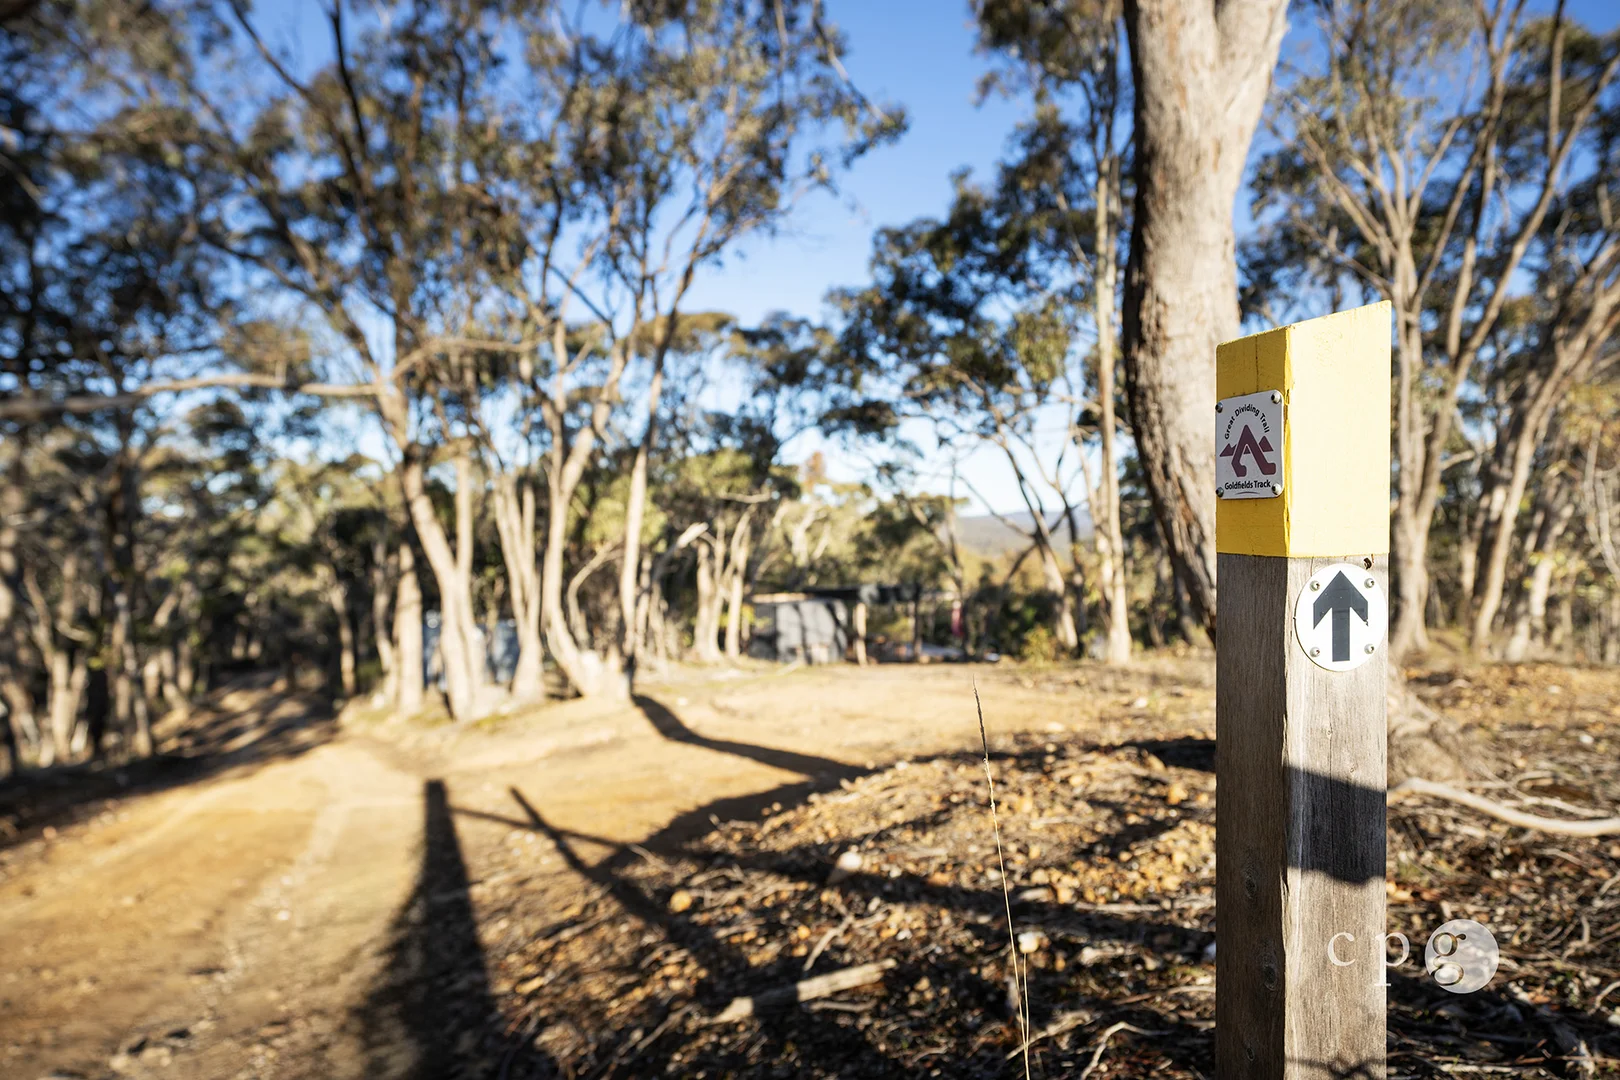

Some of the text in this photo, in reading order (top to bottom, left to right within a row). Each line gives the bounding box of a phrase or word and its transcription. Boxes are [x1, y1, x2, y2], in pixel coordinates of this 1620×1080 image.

[1224, 403, 1270, 440] Great Dividing Trail
[1224, 479, 1271, 490] Goldfields Track
